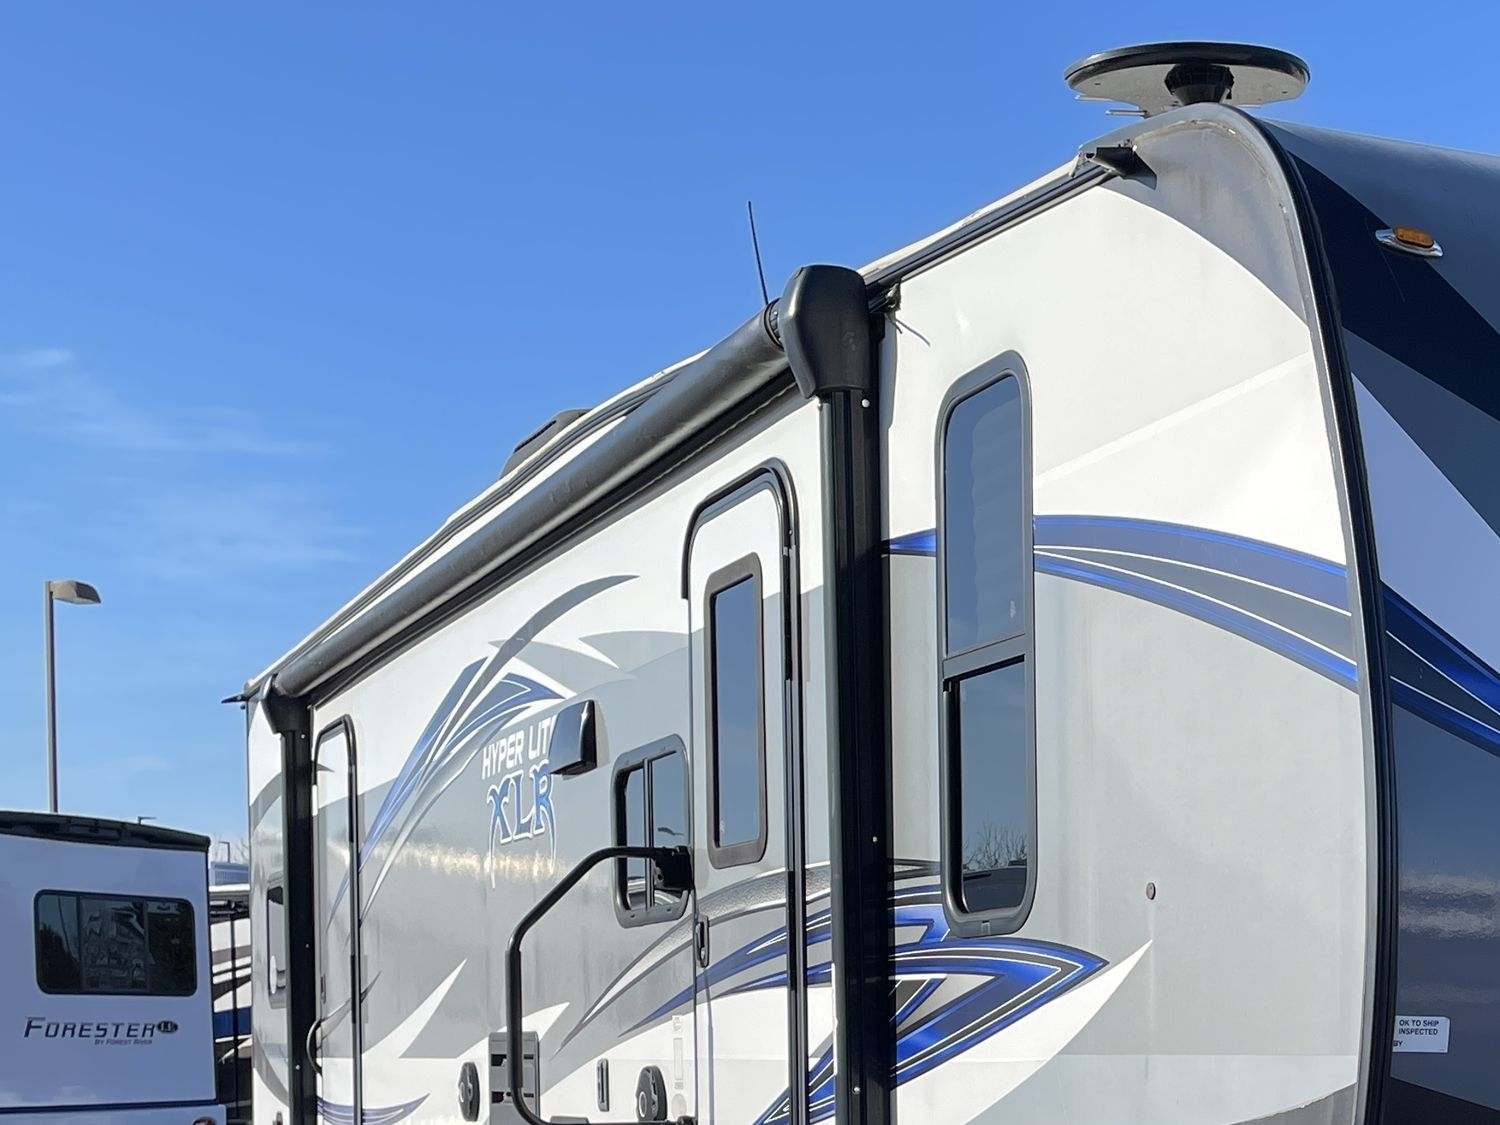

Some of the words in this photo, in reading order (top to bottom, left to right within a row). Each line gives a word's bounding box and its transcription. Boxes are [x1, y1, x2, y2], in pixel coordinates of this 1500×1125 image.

[481, 729, 525, 781] HYPER
[486, 758, 557, 889] XLR
[23, 1016, 156, 1039] FORESTER
[1398, 1019, 1410, 1027] OK
[1411, 1019, 1422, 1027] TO
[1422, 1019, 1440, 1028] SHIP
[1398, 1027, 1439, 1036] INSPECTED
